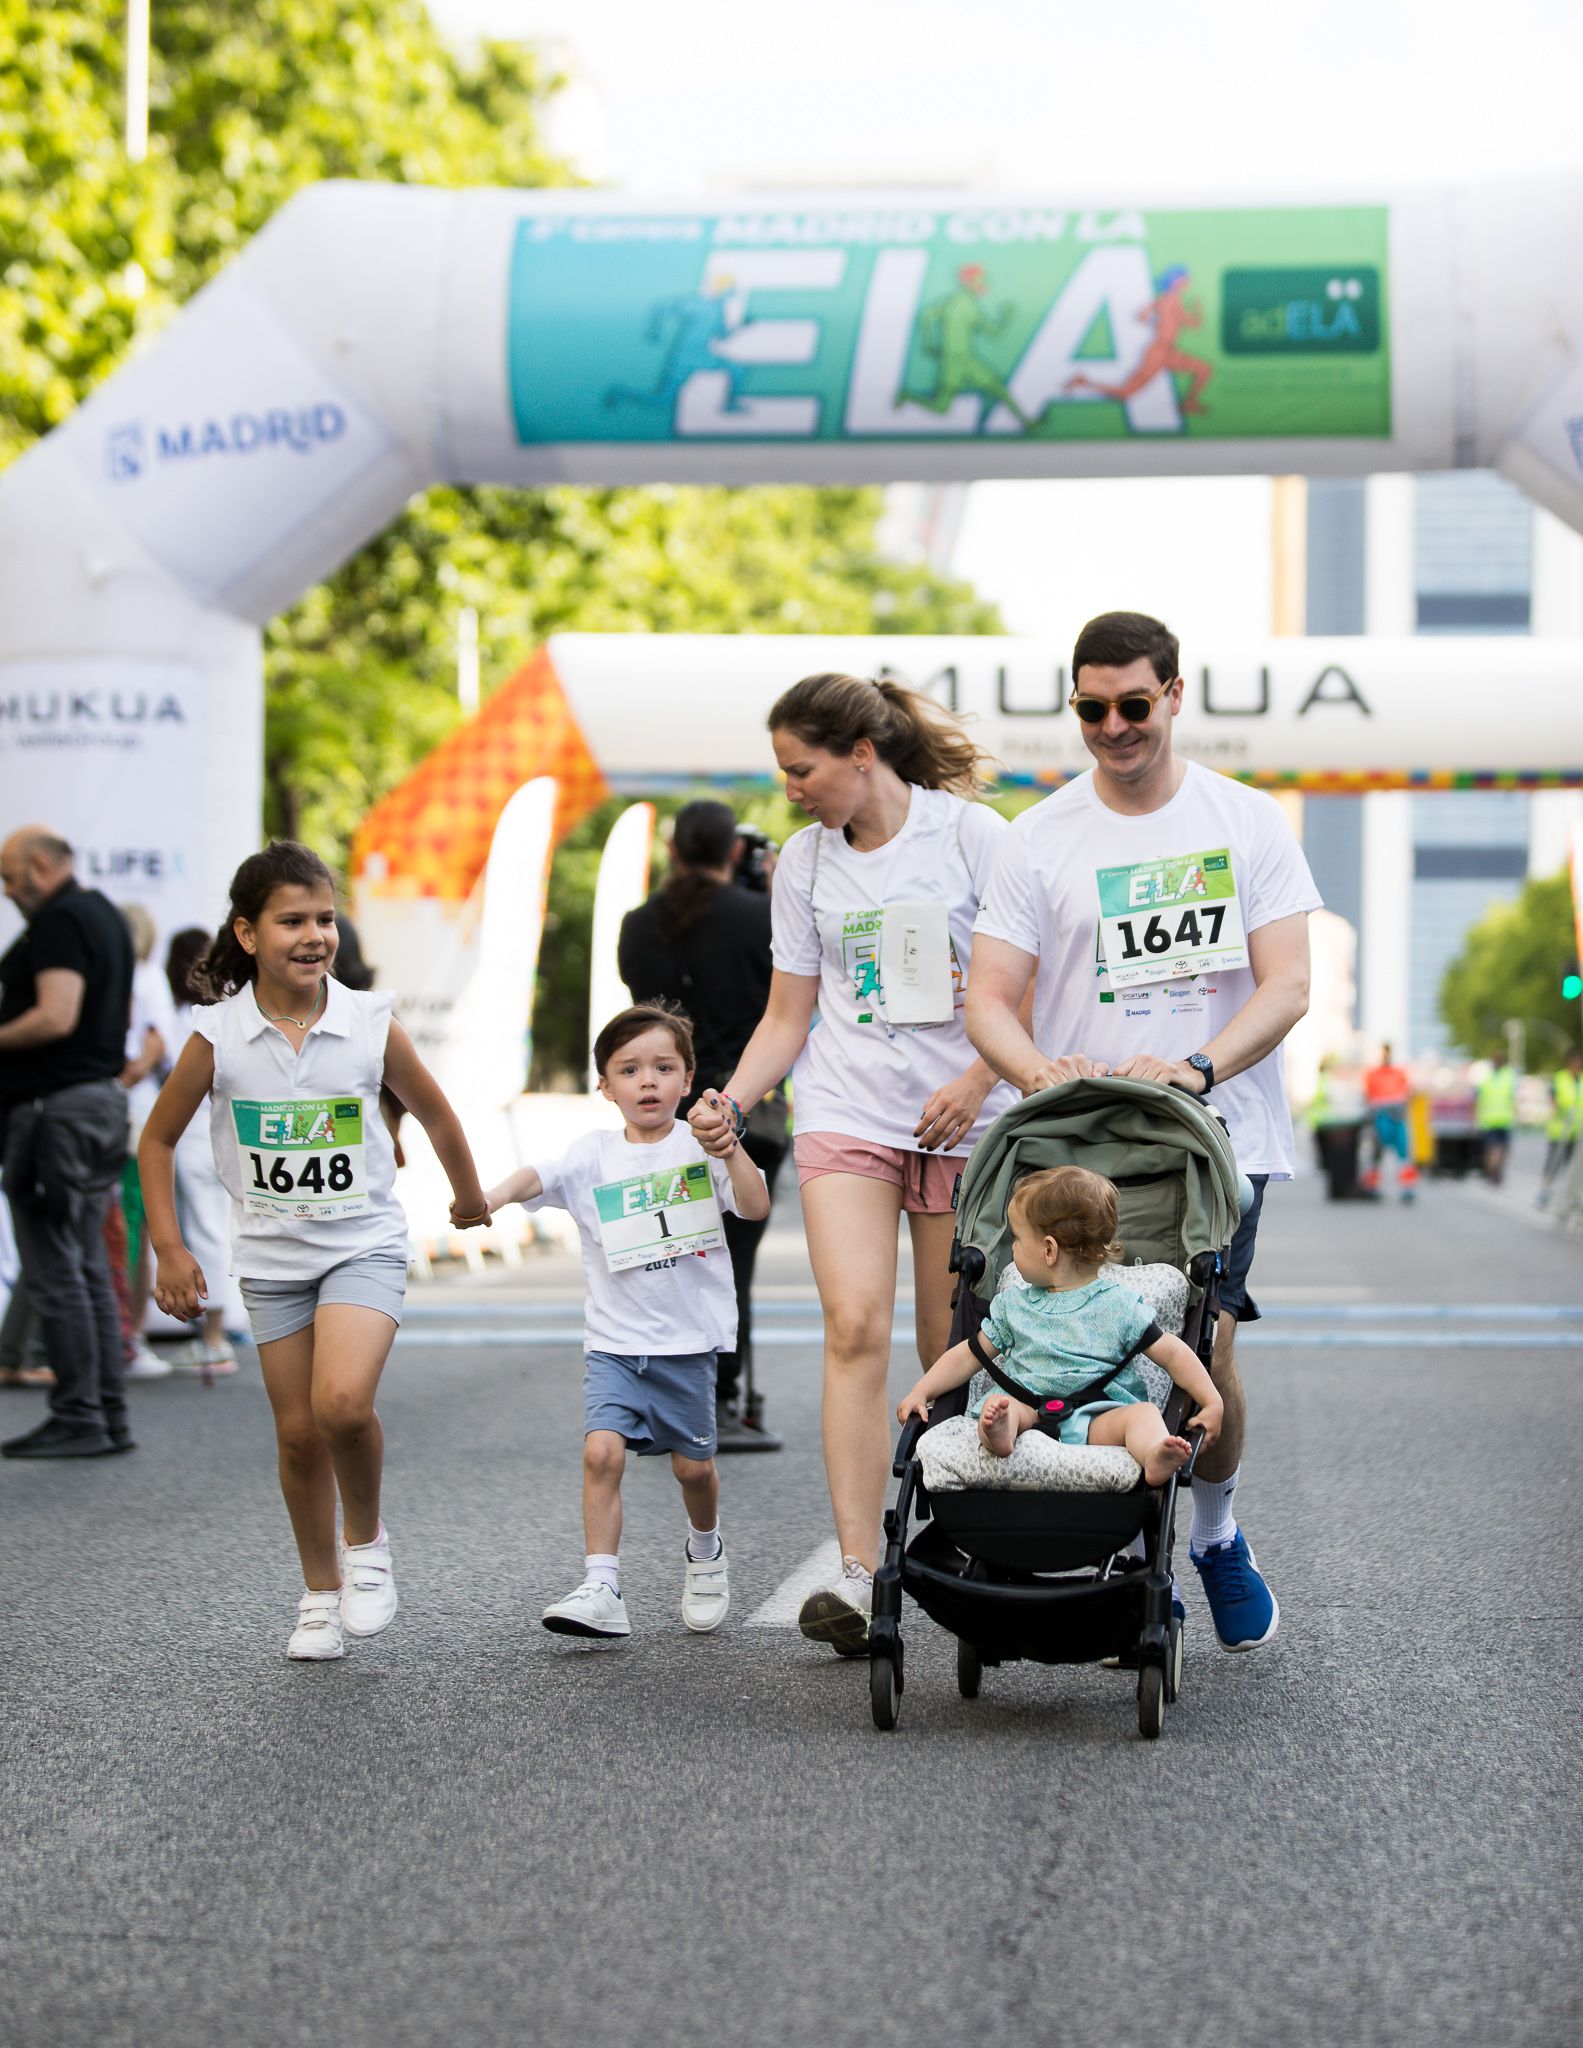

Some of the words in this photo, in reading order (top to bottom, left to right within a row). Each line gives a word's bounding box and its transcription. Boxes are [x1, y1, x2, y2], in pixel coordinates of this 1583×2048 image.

[712, 213, 937, 246] MADRID
[945, 210, 1066, 243] CON
[1076, 209, 1148, 241] LA
[671, 245, 1186, 438] ELA
[157, 401, 348, 456] MADRID
[880, 663, 1374, 718] MUUA
[1129, 865, 1207, 908] ELA
[1130, 863, 1164, 876] MADRID
[1165, 859, 1183, 870] CON
[1117, 905, 1226, 960] 1647
[1169, 989, 1191, 998] Biogen
[260, 1104, 294, 1113] MADRID
[296, 1103, 315, 1111] CON
[316, 1103, 328, 1111] LA
[260, 1111, 336, 1145] ELA
[250, 1152, 353, 1193] 1648
[622, 1174, 691, 1217] ELA
[654, 1210, 672, 1238] 1
